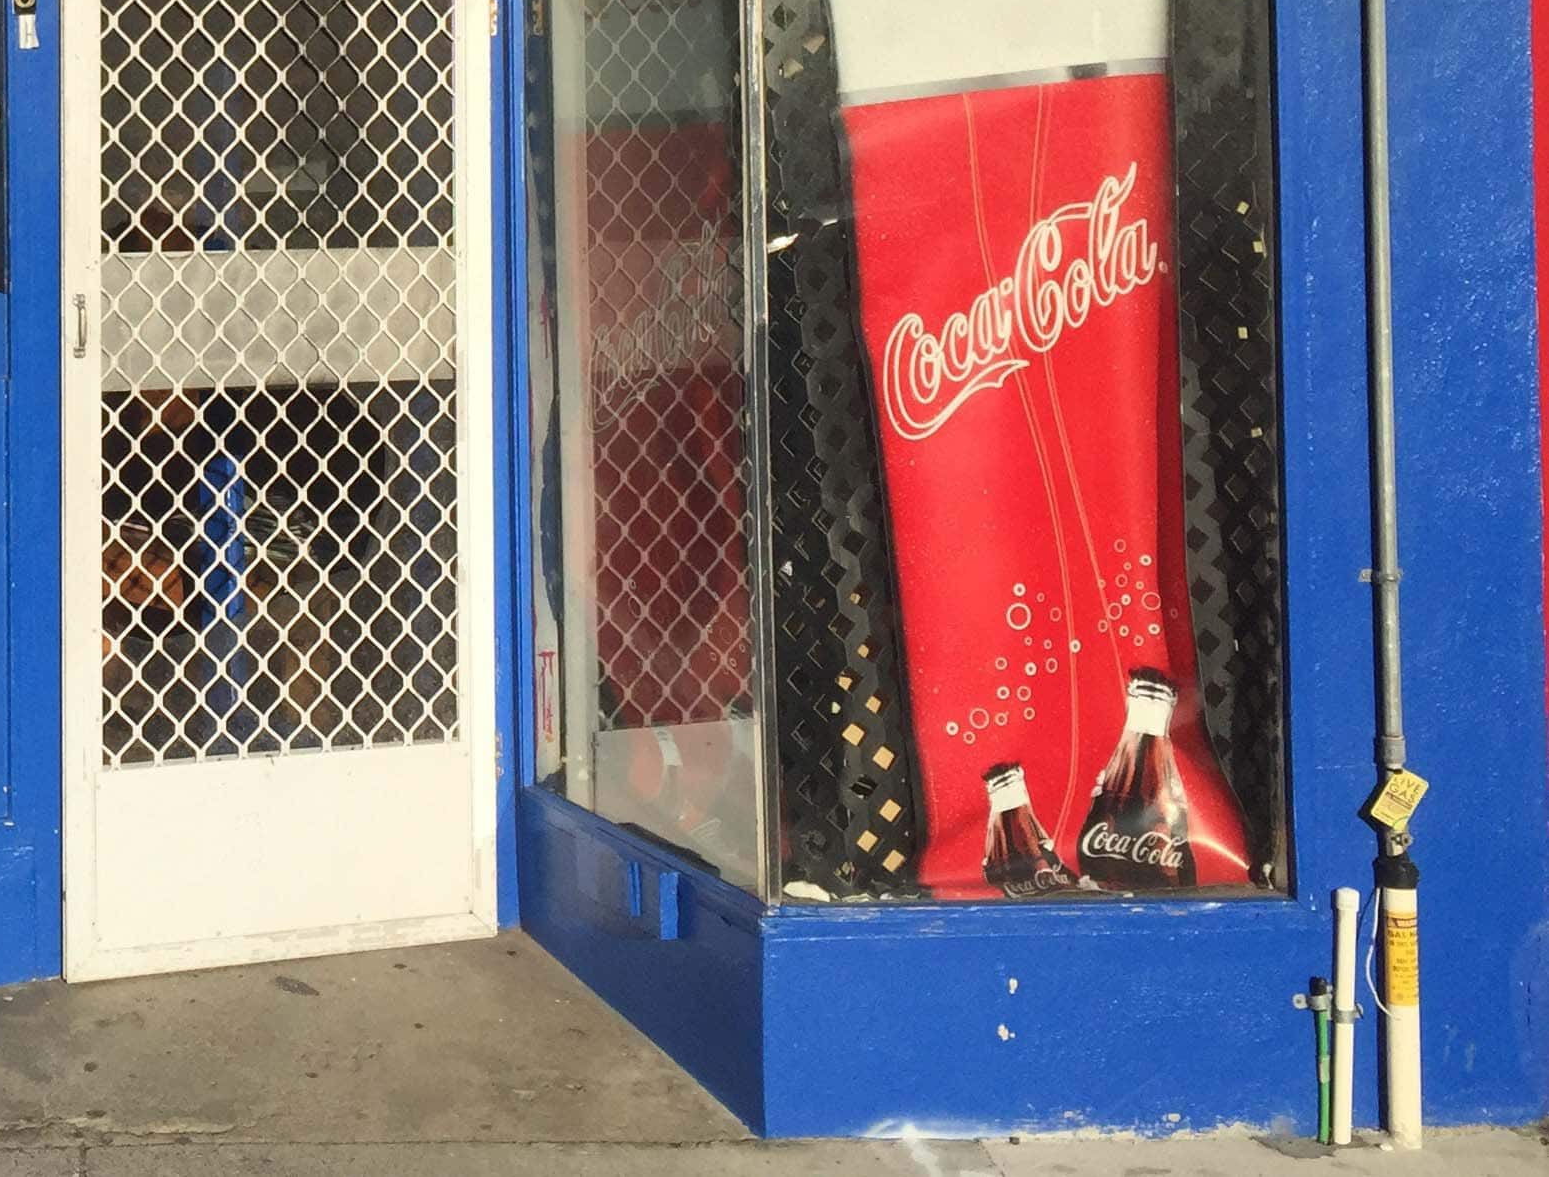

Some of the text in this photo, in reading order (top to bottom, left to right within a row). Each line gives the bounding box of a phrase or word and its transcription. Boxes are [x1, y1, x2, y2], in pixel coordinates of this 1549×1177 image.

[882, 161, 1158, 441] Coca-Cola
[1389, 783, 1415, 803] GAS
[1081, 821, 1189, 870] Coca-Cola
[1003, 860, 1072, 899] Coca-Cola
